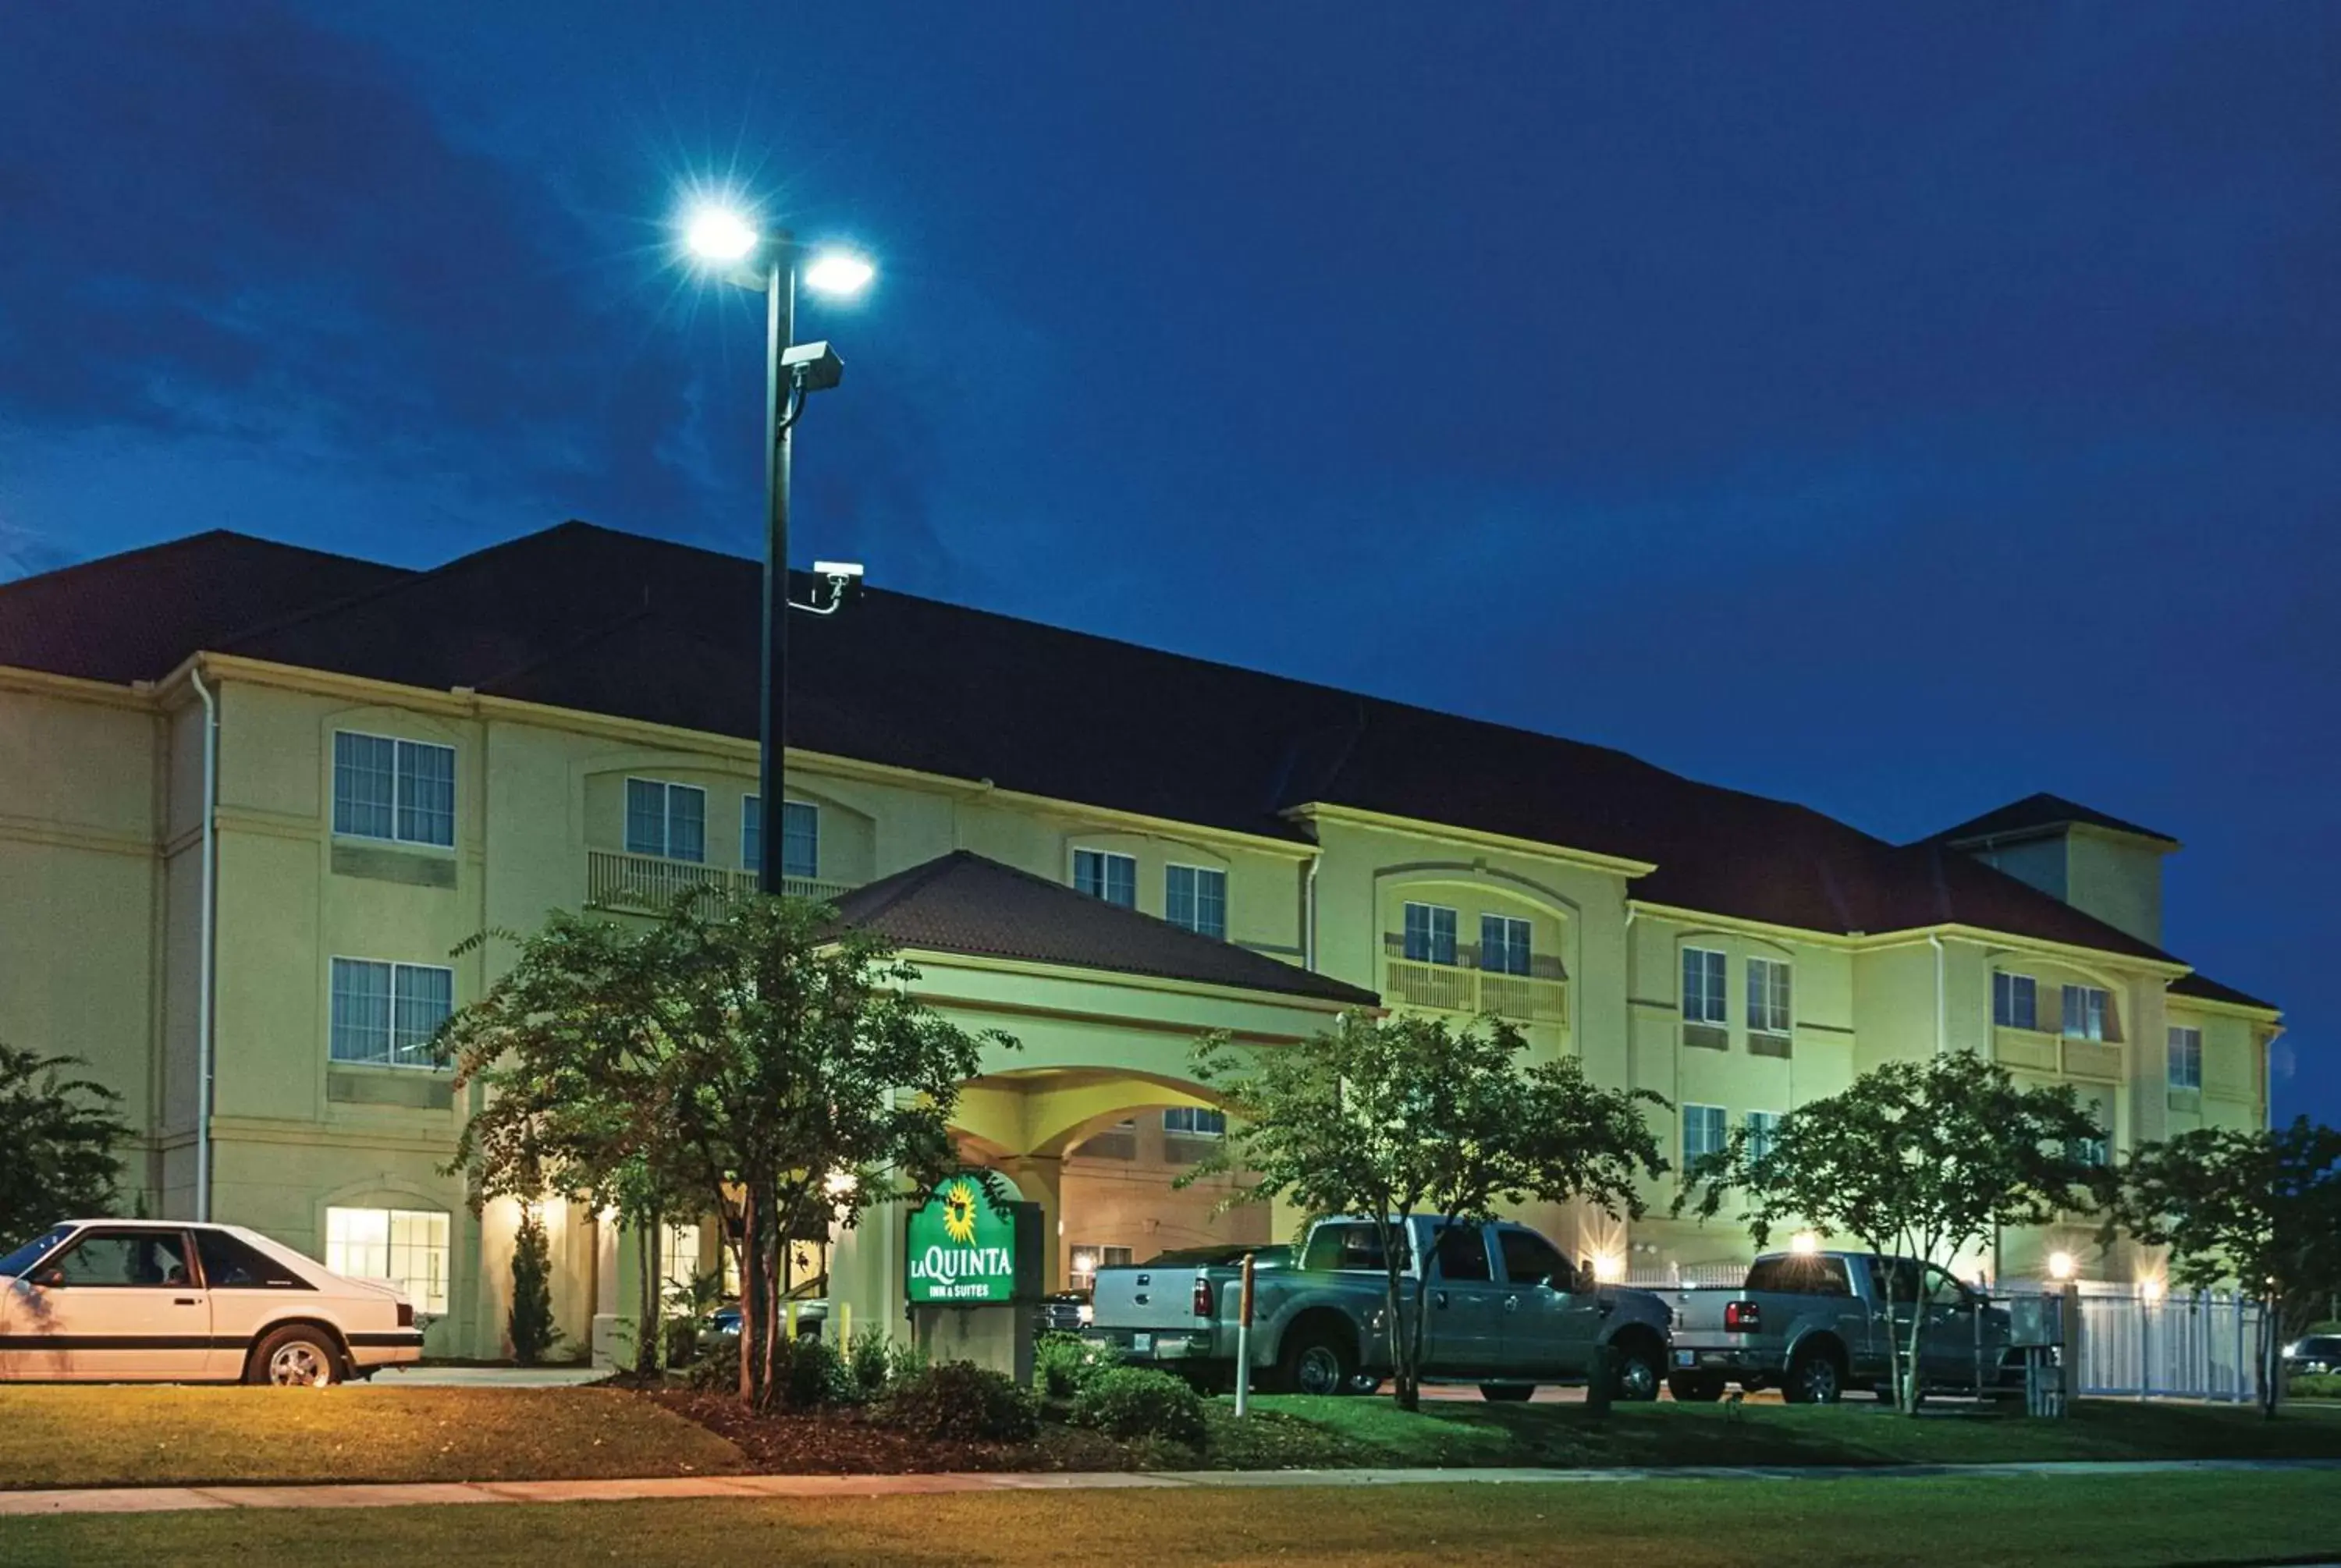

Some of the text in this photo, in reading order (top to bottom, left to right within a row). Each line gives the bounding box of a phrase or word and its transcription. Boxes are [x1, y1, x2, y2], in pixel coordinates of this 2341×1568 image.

[911, 1246, 1012, 1284] LA QUINTA
[929, 1284, 989, 1298] INN & SUITES
